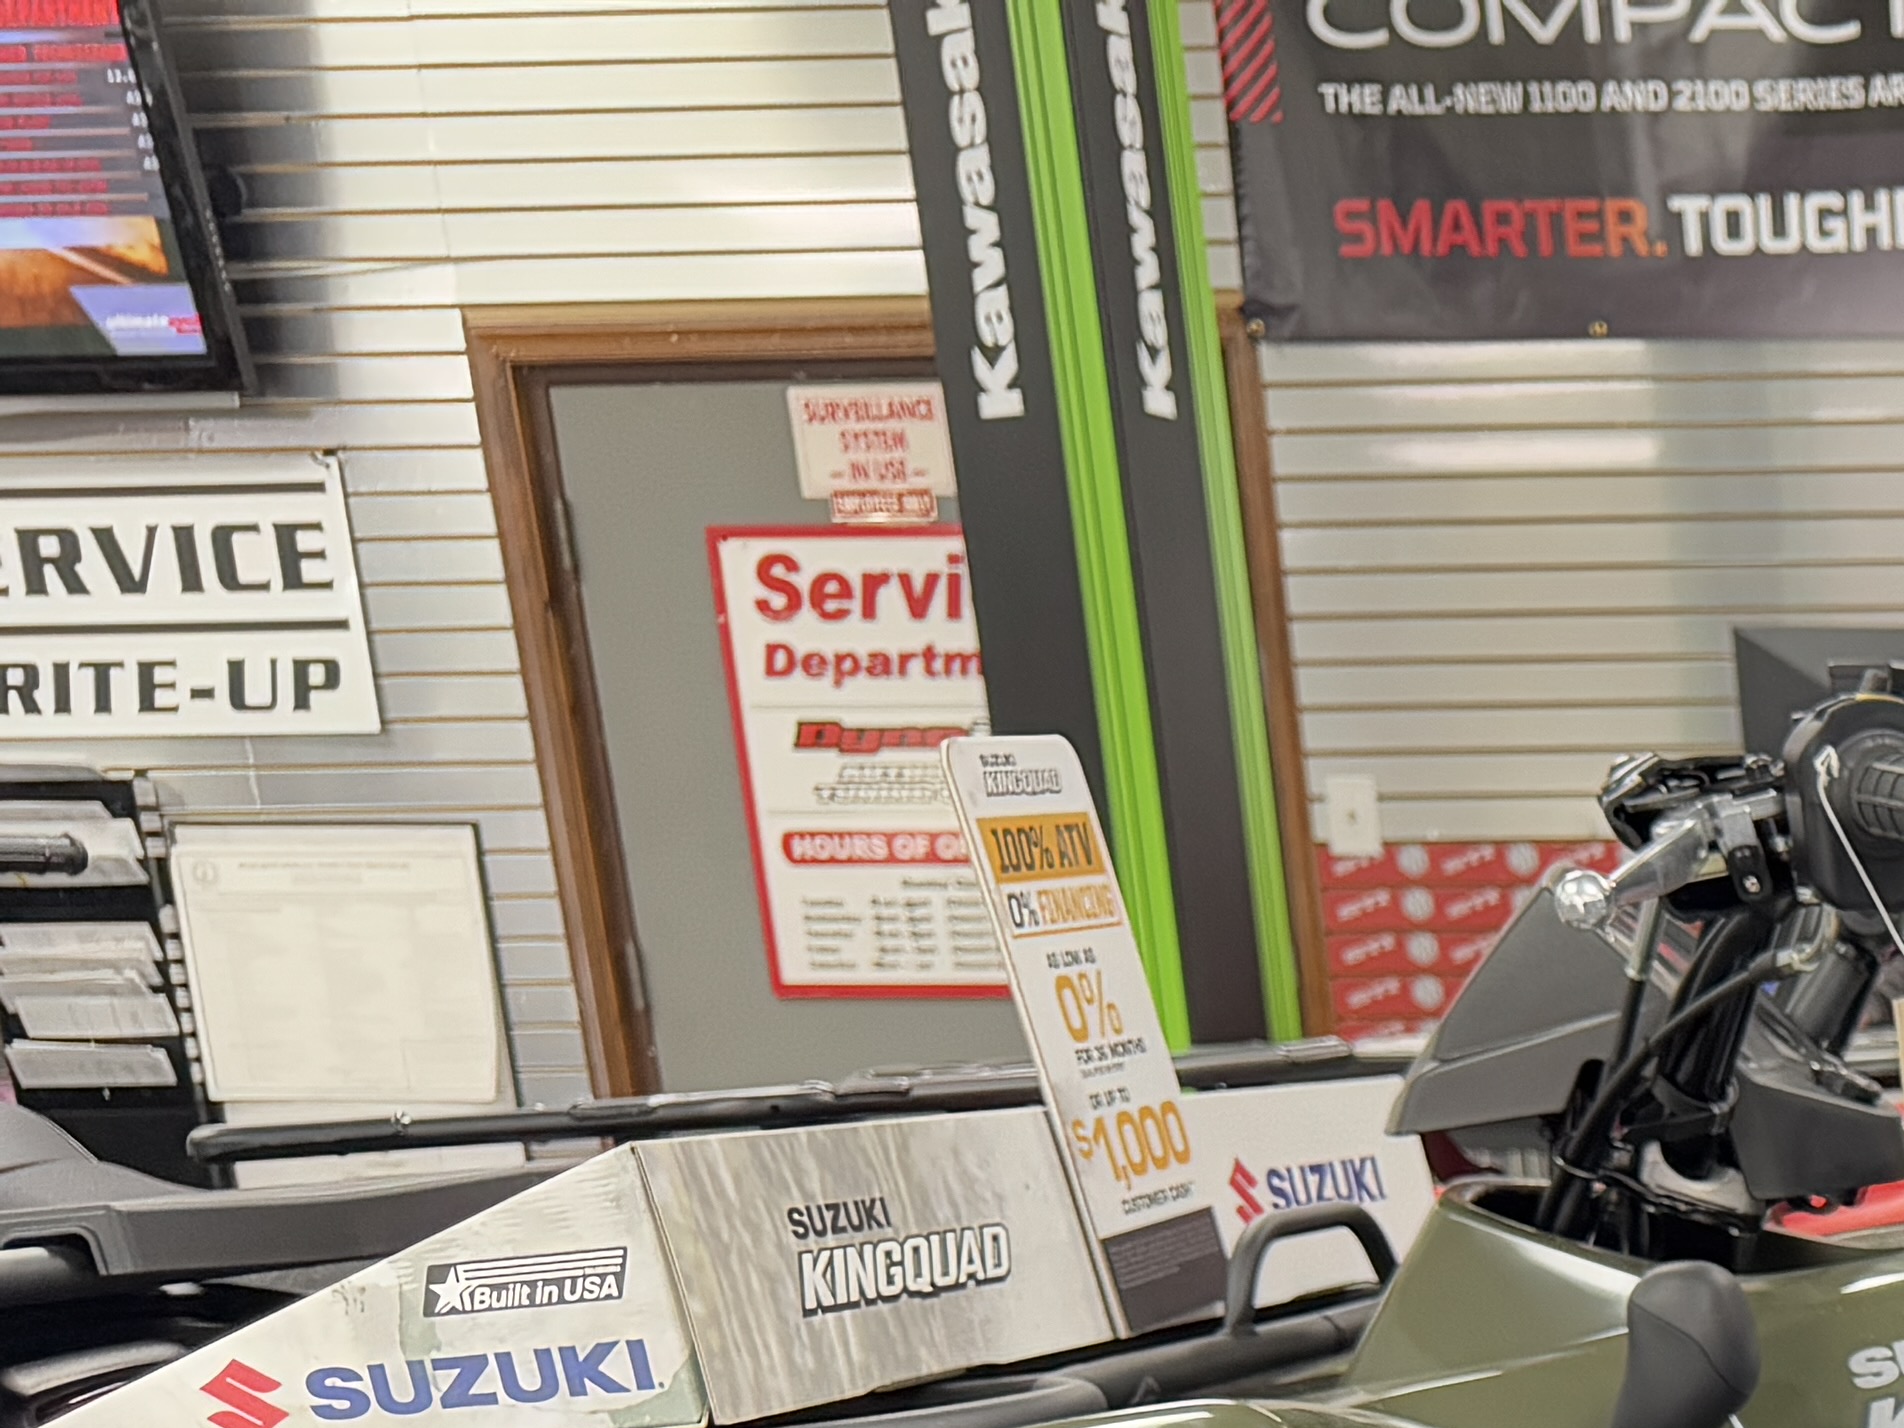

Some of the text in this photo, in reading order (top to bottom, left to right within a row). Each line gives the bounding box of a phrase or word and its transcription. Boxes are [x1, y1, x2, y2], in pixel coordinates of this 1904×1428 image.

[1318, 83, 1380, 115] THE
[1387, 81, 1524, 116] ALL-NEW
[1528, 80, 1597, 113] 1100
[1601, 79, 1667, 113] AND
[1672, 78, 1747, 112] 2100
[1752, 77, 1864, 112] SERIES
[1332, 198, 1668, 259] SMARTER.
[0, 520, 334, 597] RVICE
[754, 552, 965, 621] Servi
[764, 642, 984, 689] Departm
[991, 824, 1056, 874] 100%
[1055, 820, 1093, 868] ATV
[1055, 969, 1124, 1043] 0%
[1071, 1099, 1191, 1191] $1,000
[1264, 1154, 1389, 1211] SUZUKI
[787, 1196, 892, 1242] SUZUKI
[472, 1274, 619, 1311] Built in USA
[800, 1222, 1012, 1316] KINGQUAD
[305, 1338, 657, 1421] SUZUKI
